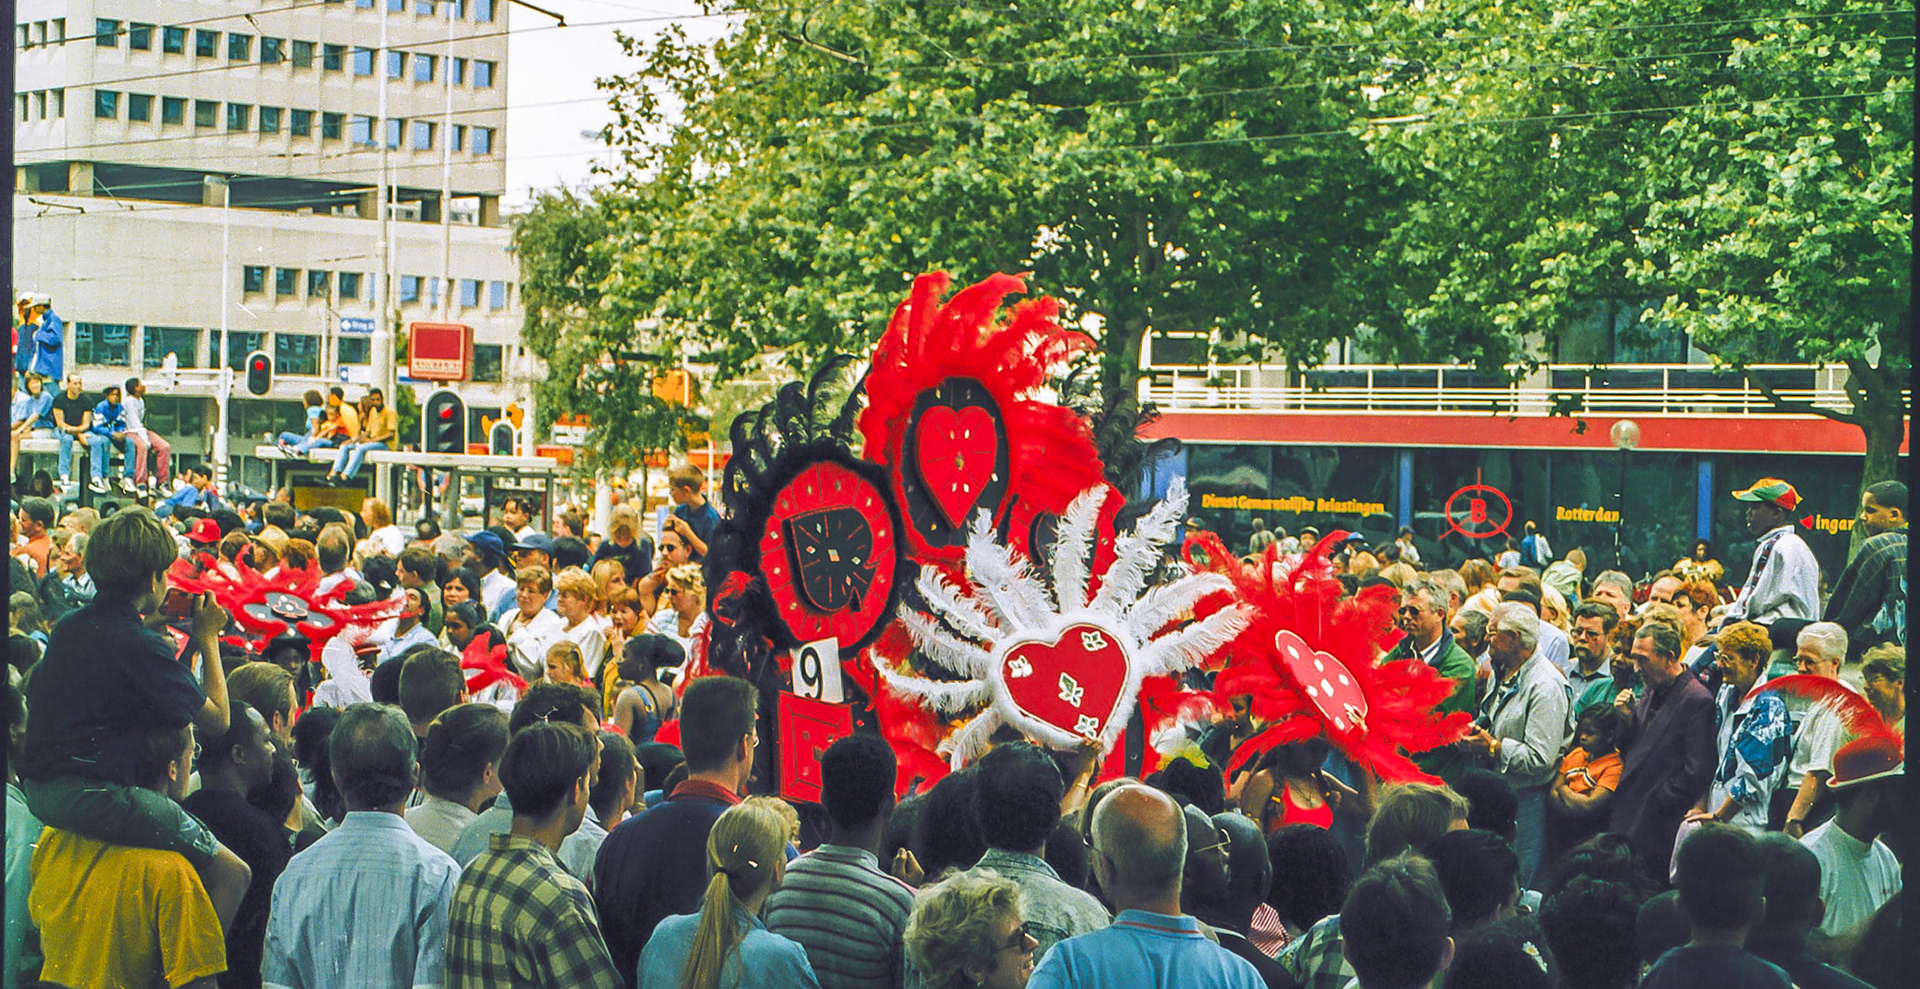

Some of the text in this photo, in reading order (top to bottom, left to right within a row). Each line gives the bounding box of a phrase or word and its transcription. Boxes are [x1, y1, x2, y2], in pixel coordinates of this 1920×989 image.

[1202, 493, 1237, 509] Dienst
[1317, 497, 1384, 516] Belastingen
[1470, 498, 1487, 523] B
[801, 646, 823, 699] 9
